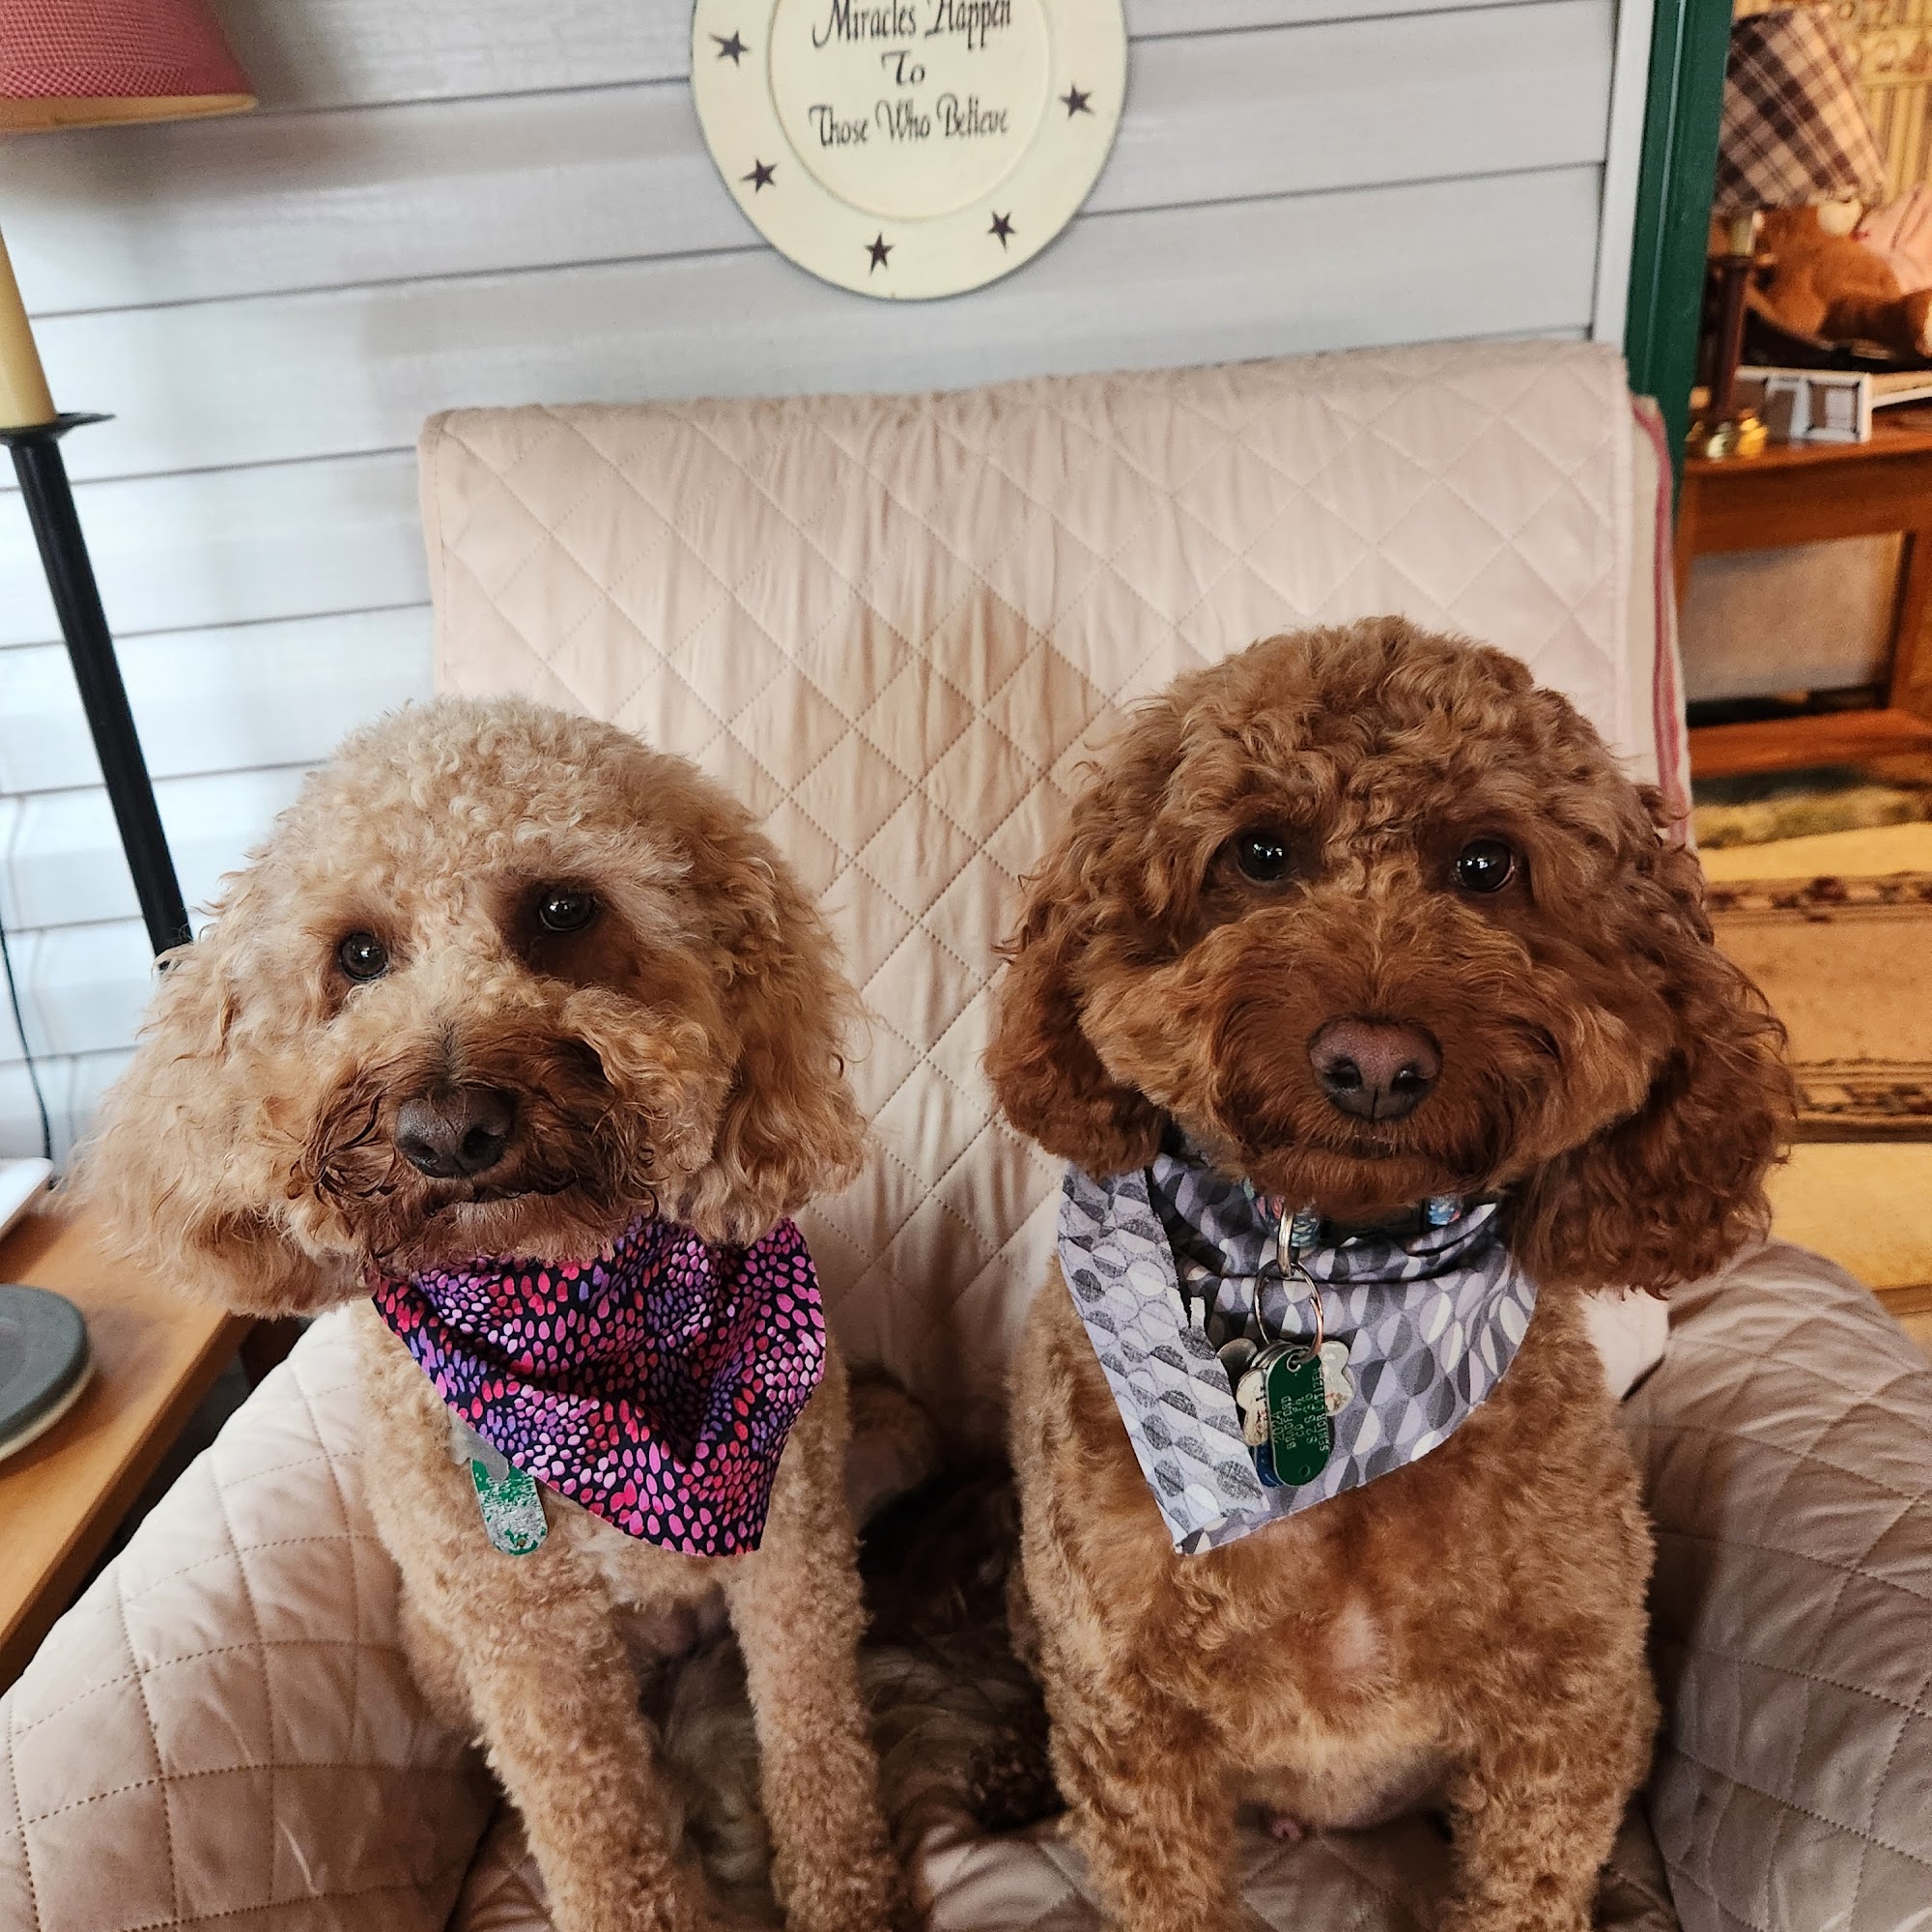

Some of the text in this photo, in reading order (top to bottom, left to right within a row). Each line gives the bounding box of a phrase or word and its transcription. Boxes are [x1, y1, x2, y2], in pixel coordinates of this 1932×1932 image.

[811, 0, 1011, 49] Miracles Happen
[880, 49, 925, 86] To
[808, 92, 1010, 146] Those Who Believe
[1271, 1410, 1284, 1443] 2024
[1280, 1395, 1296, 1450] BRADFORD
[1316, 1412, 1329, 1451] SENIOR
